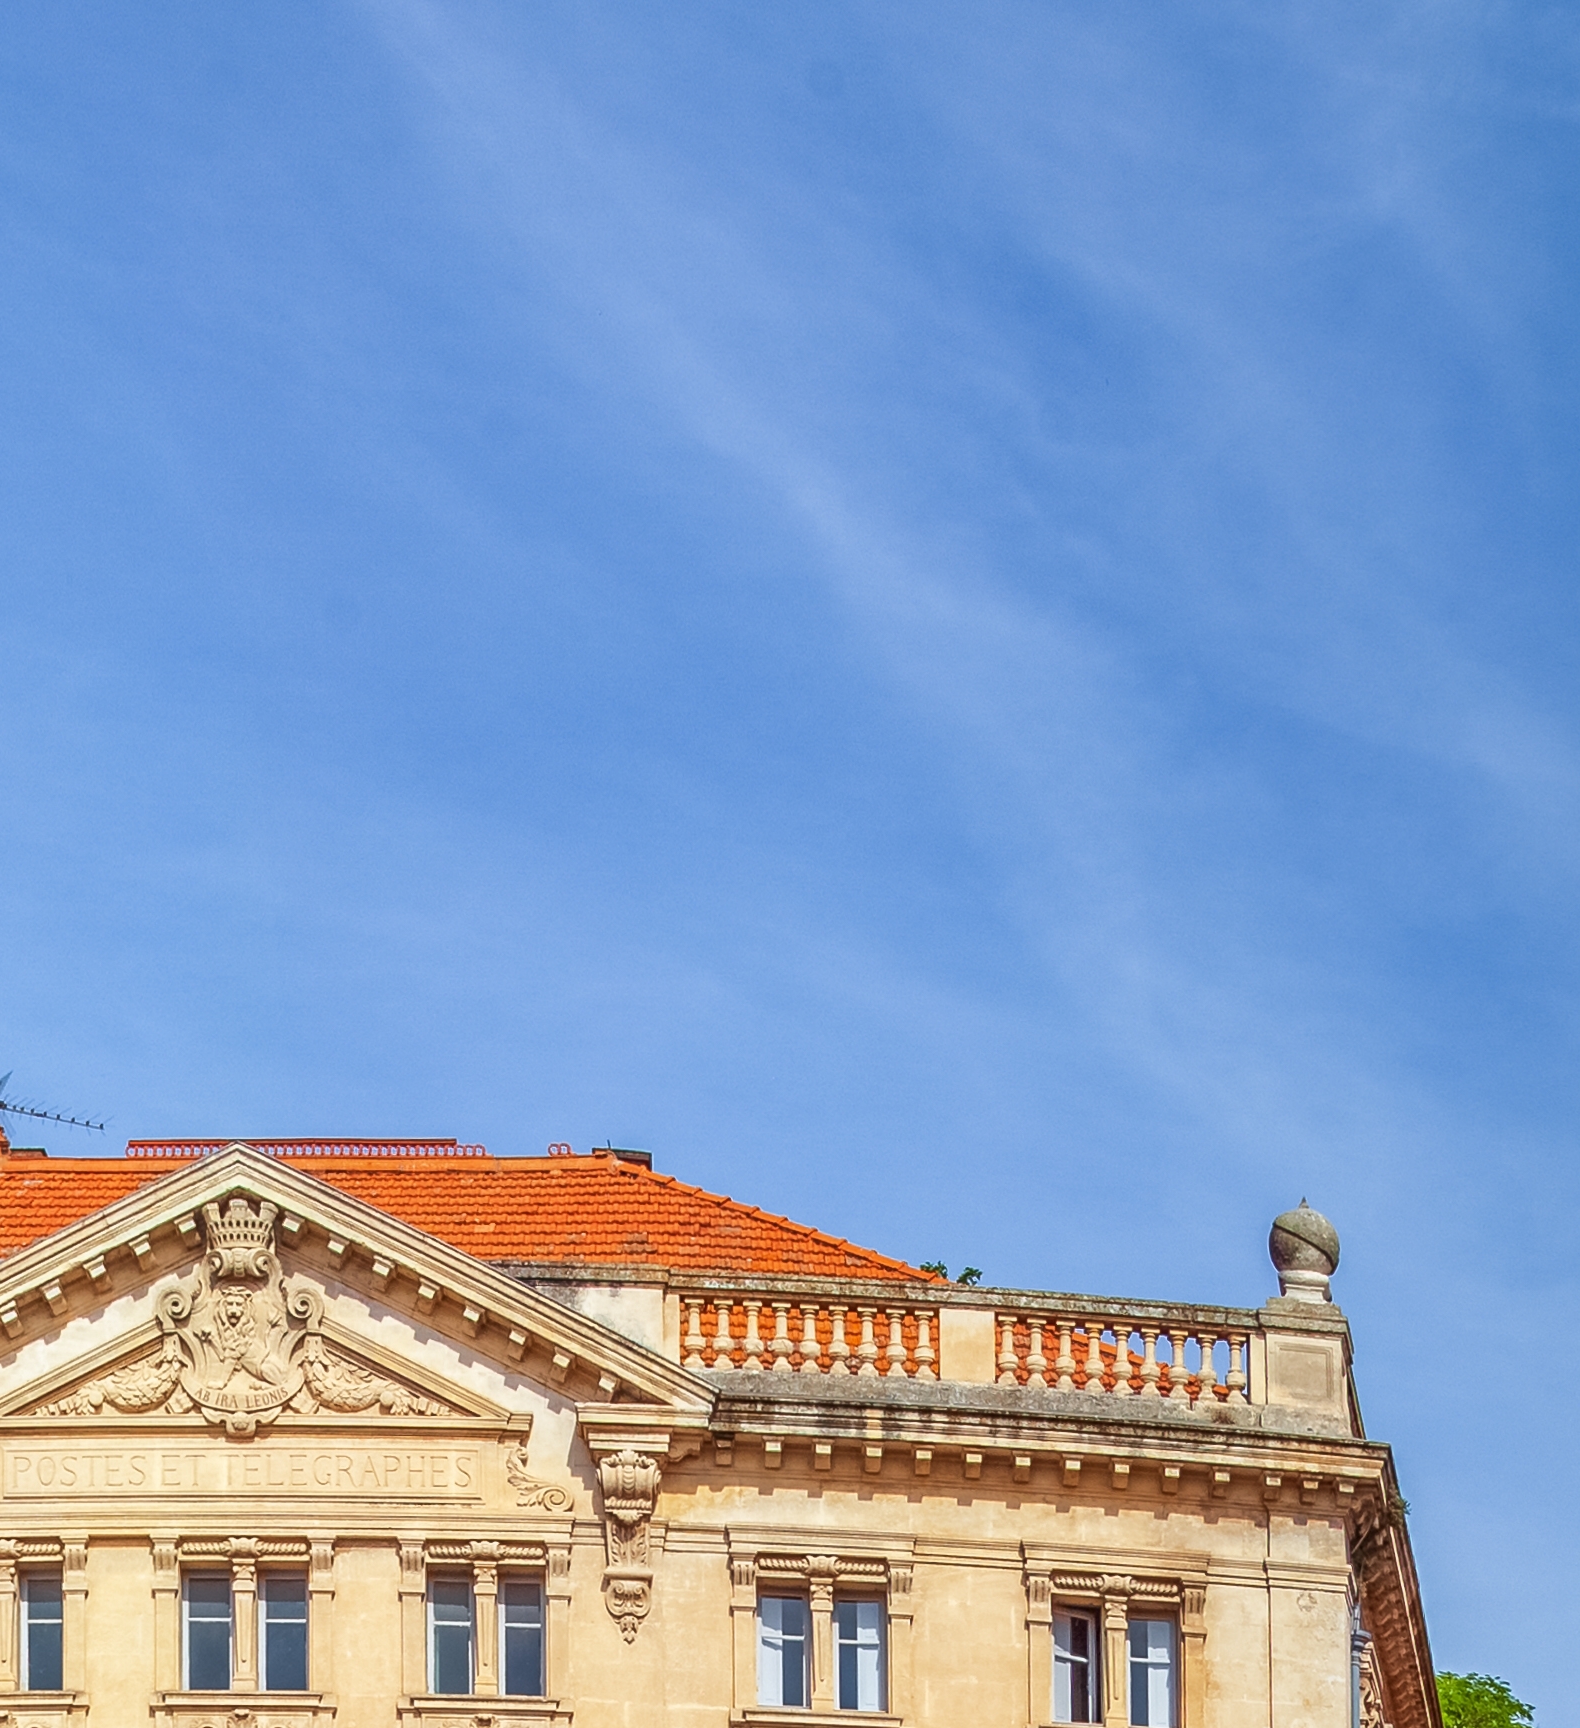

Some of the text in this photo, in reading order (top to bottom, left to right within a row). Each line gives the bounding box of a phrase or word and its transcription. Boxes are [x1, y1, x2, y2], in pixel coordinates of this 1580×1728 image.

[194, 1386, 289, 1409] AB IRA LEONIS
[11, 1453, 472, 1488] POSTES ET TELEGRAPHES
